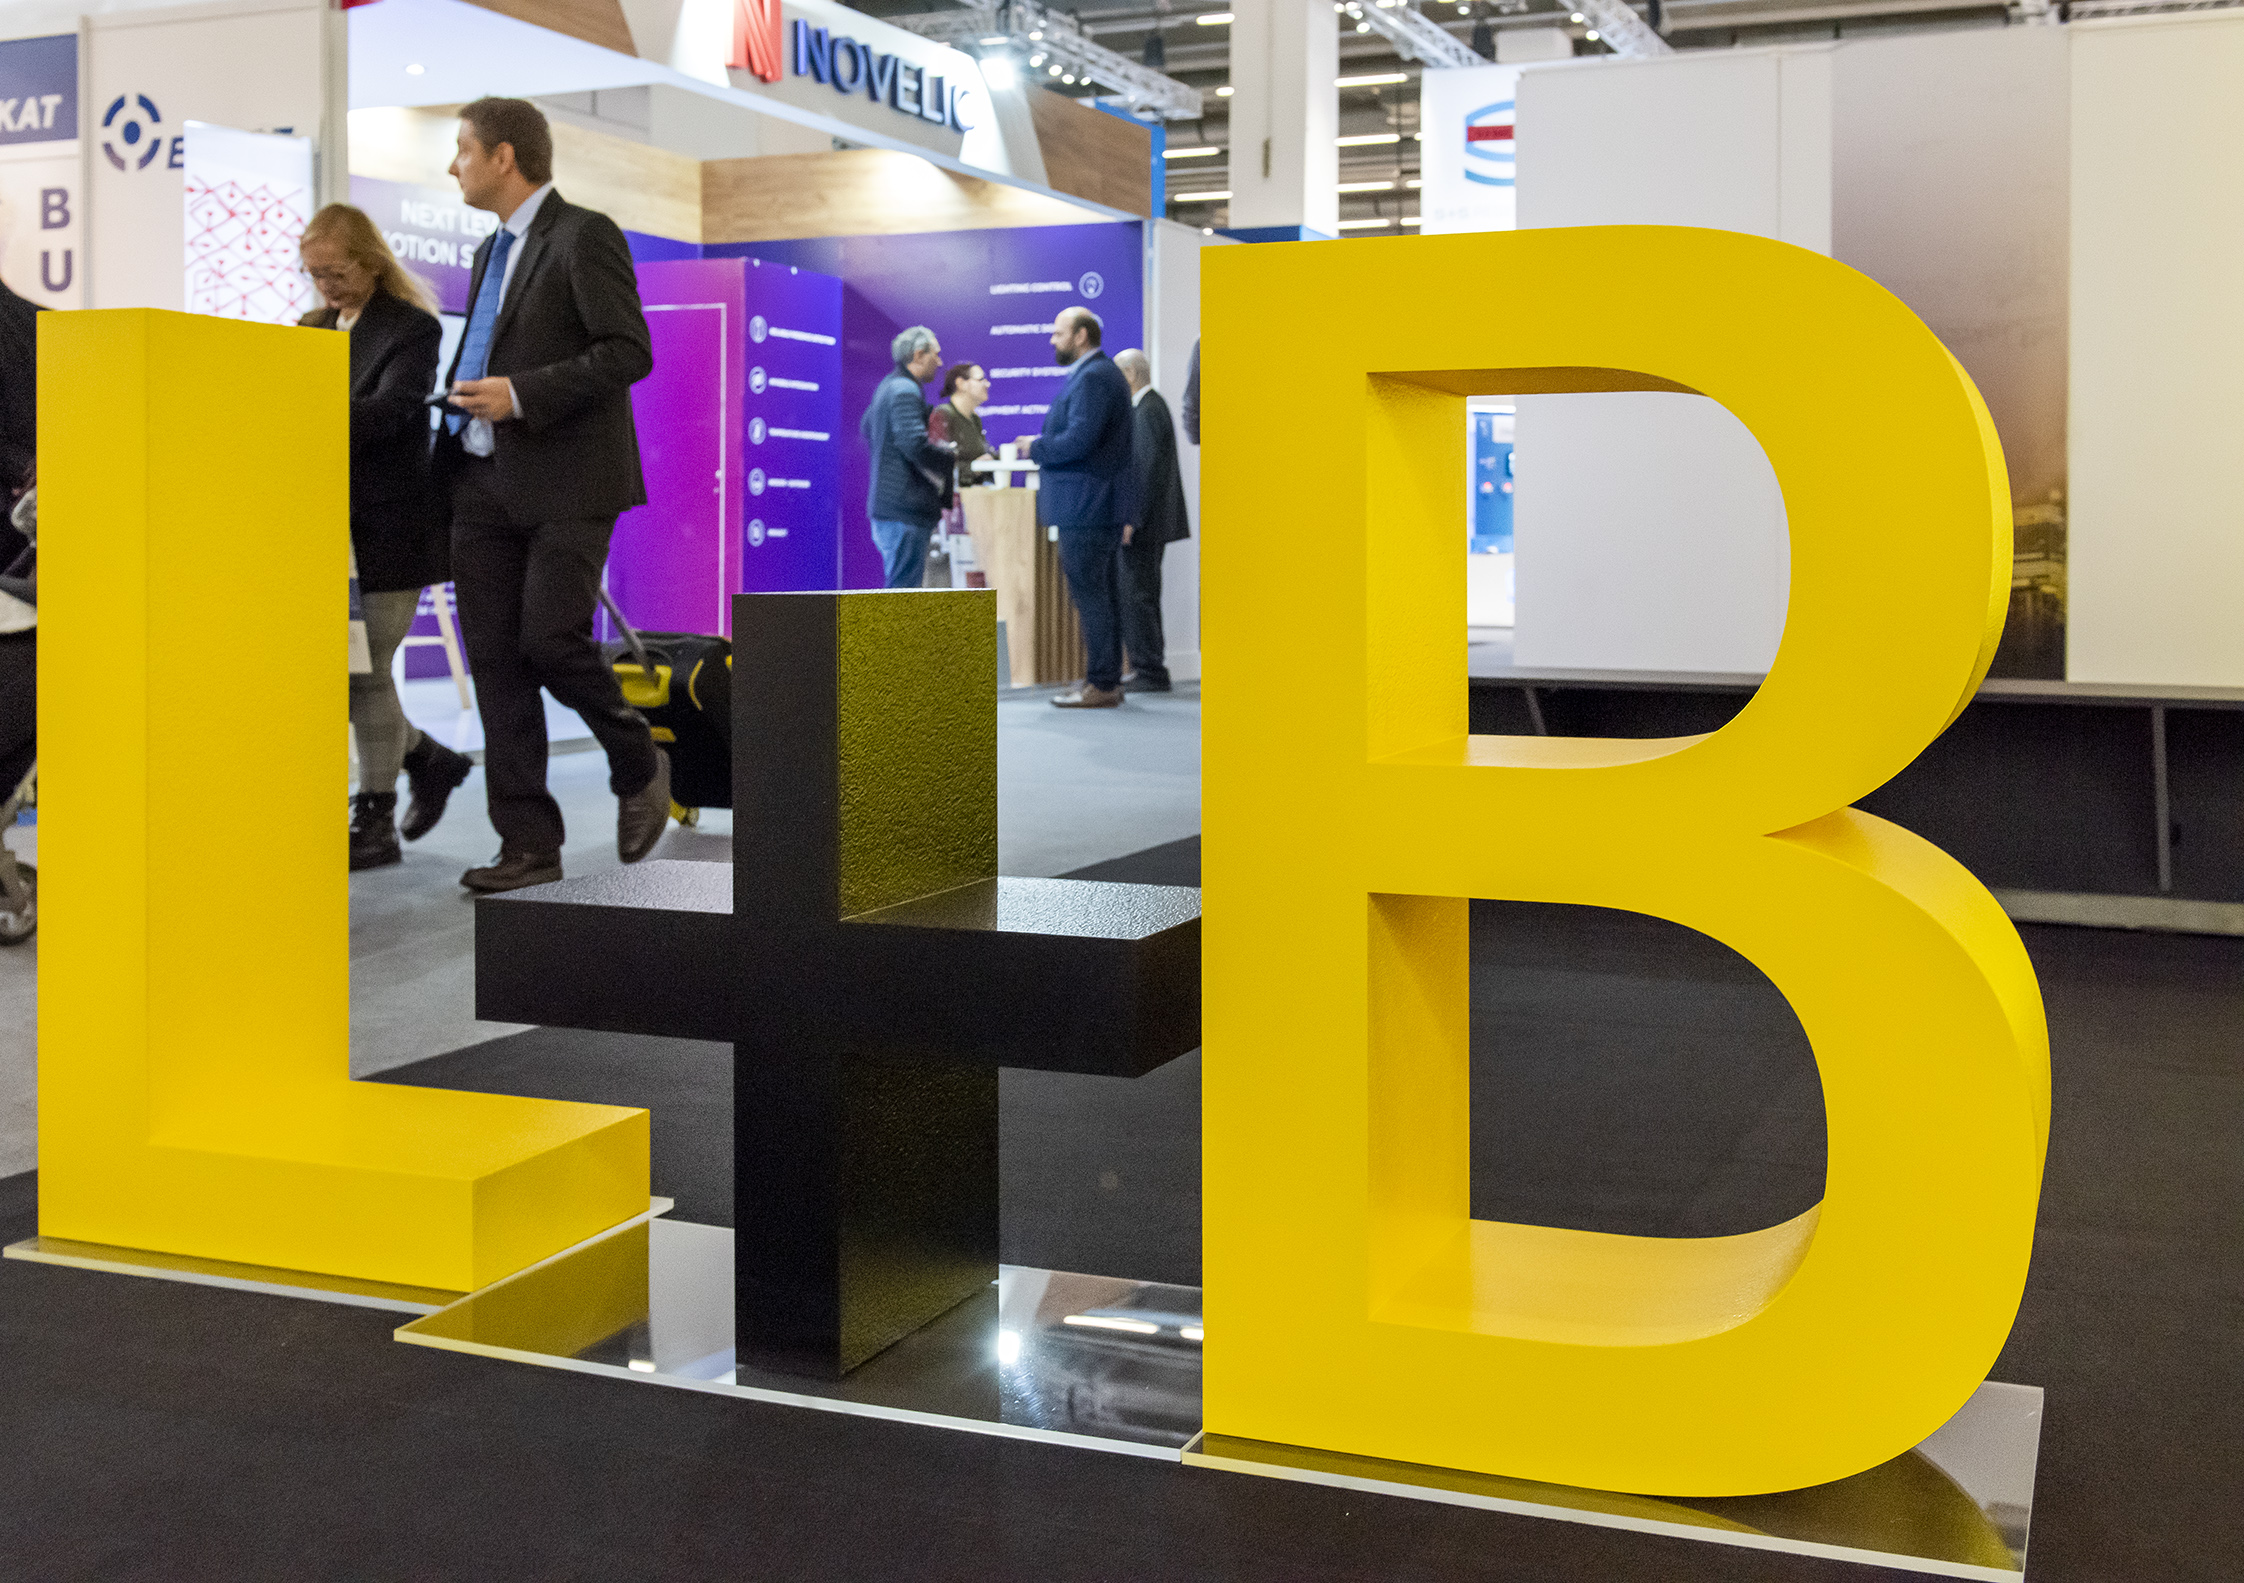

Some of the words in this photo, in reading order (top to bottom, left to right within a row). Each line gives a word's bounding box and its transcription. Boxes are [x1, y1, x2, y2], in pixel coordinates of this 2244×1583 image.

[793, 18, 976, 133] NOVELIC
[0, 94, 62, 131] KAT
[400, 200, 457, 232] NEXT
[460, 210, 500, 238] LEV
[383, 231, 458, 267] OTION
[460, 243, 474, 269] S
